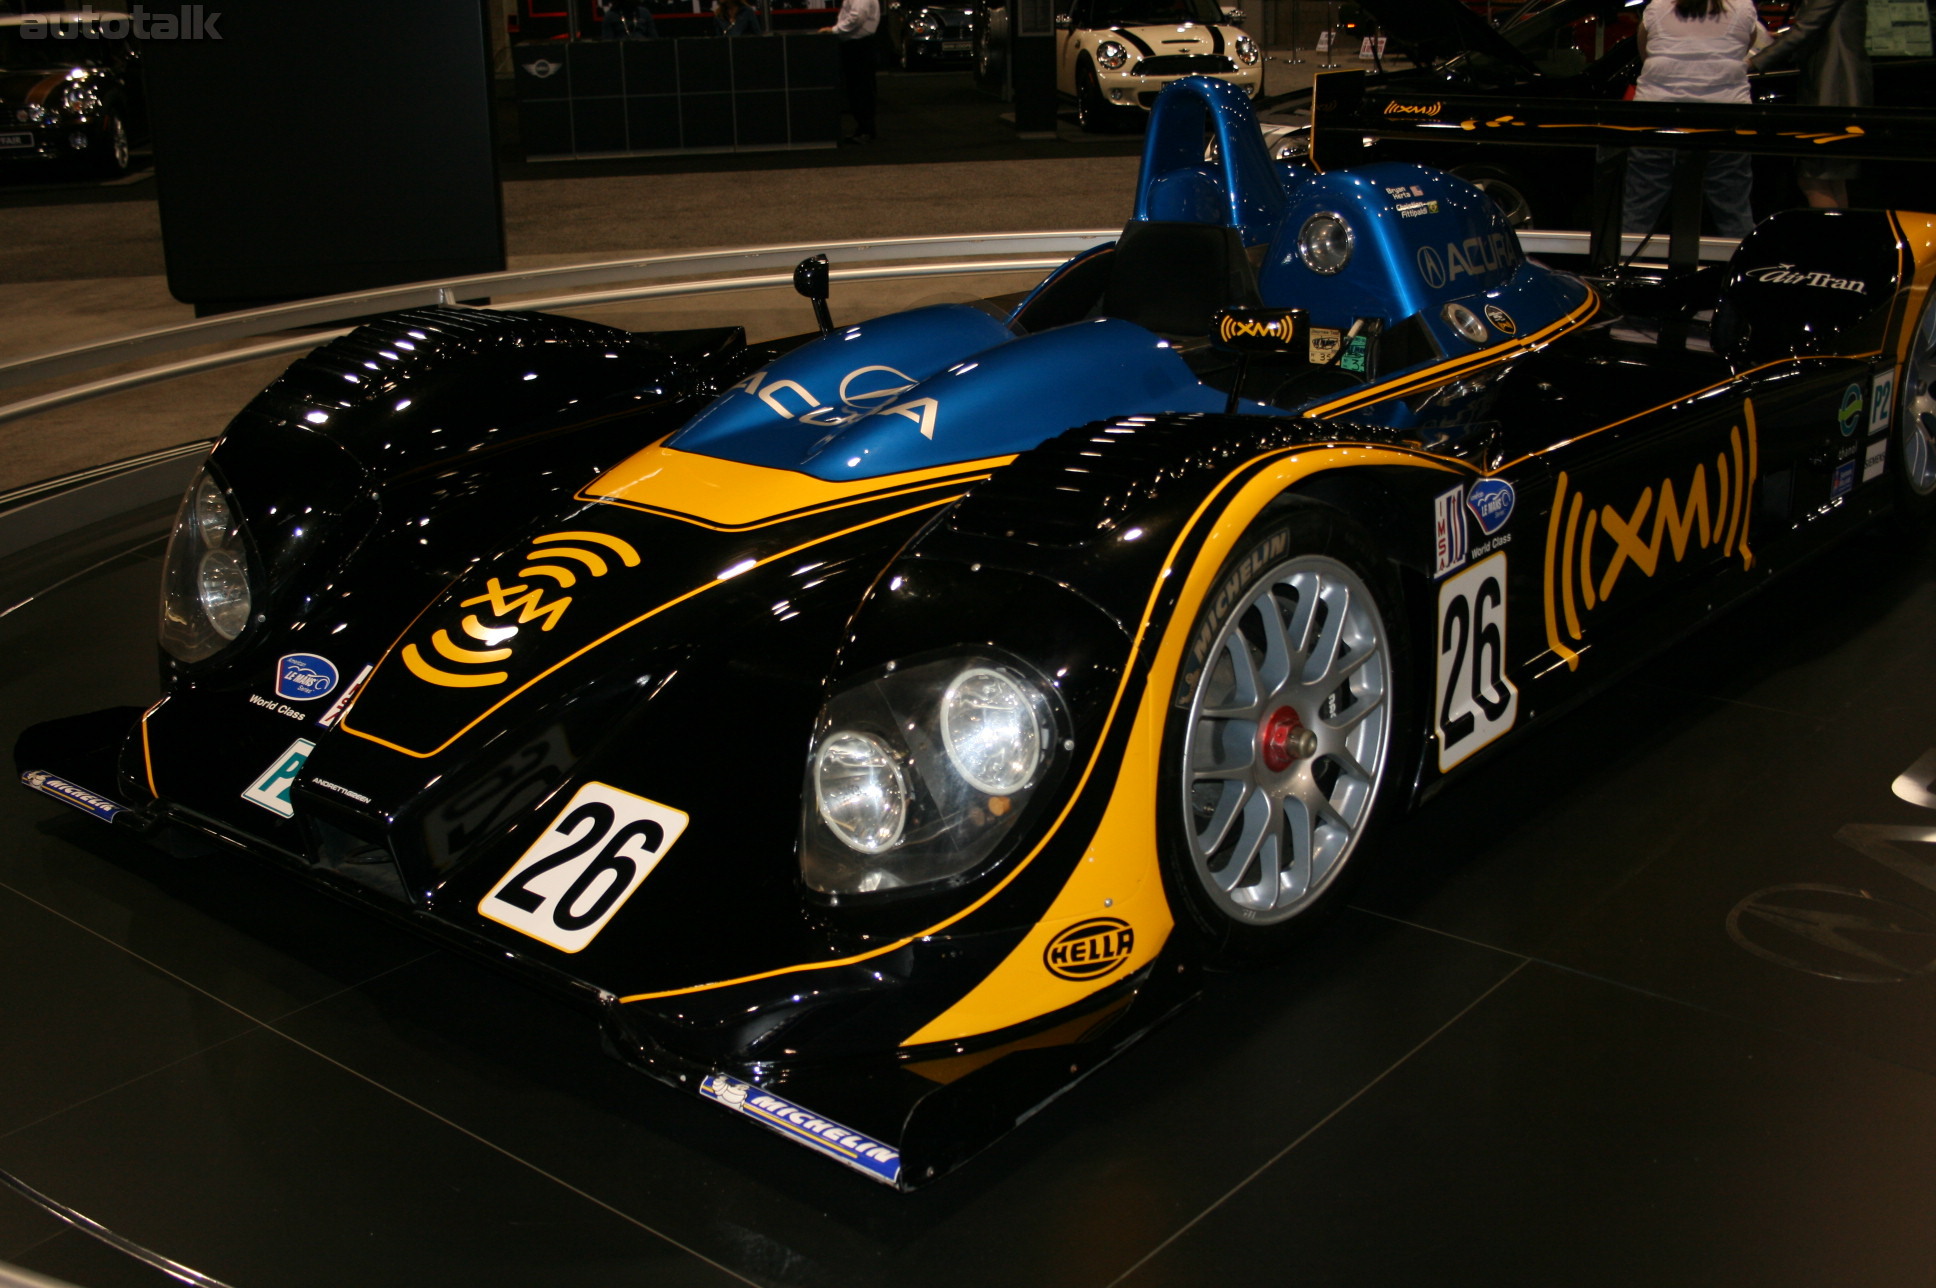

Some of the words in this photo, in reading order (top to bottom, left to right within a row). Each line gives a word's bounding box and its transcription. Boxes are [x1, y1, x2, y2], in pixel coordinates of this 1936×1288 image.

[1447, 232, 1514, 281] ACURA
[1872, 380, 1891, 424] P2
[1438, 501, 1446, 571] IMSA
[1471, 541, 1490, 559] World
[1492, 533, 1511, 549] Class
[1194, 531, 1287, 663] MICHELIN
[283, 670, 297, 680] LE
[292, 674, 317, 687] MANS
[1440, 576, 1511, 750] 26
[249, 694, 278, 711] World
[277, 704, 306, 721] Class
[46, 780, 119, 811] MICHELIN
[258, 752, 308, 804] P
[494, 802, 664, 931] 26
[1051, 928, 1134, 964] HELLA
[751, 1095, 900, 1163] MICHELIN
